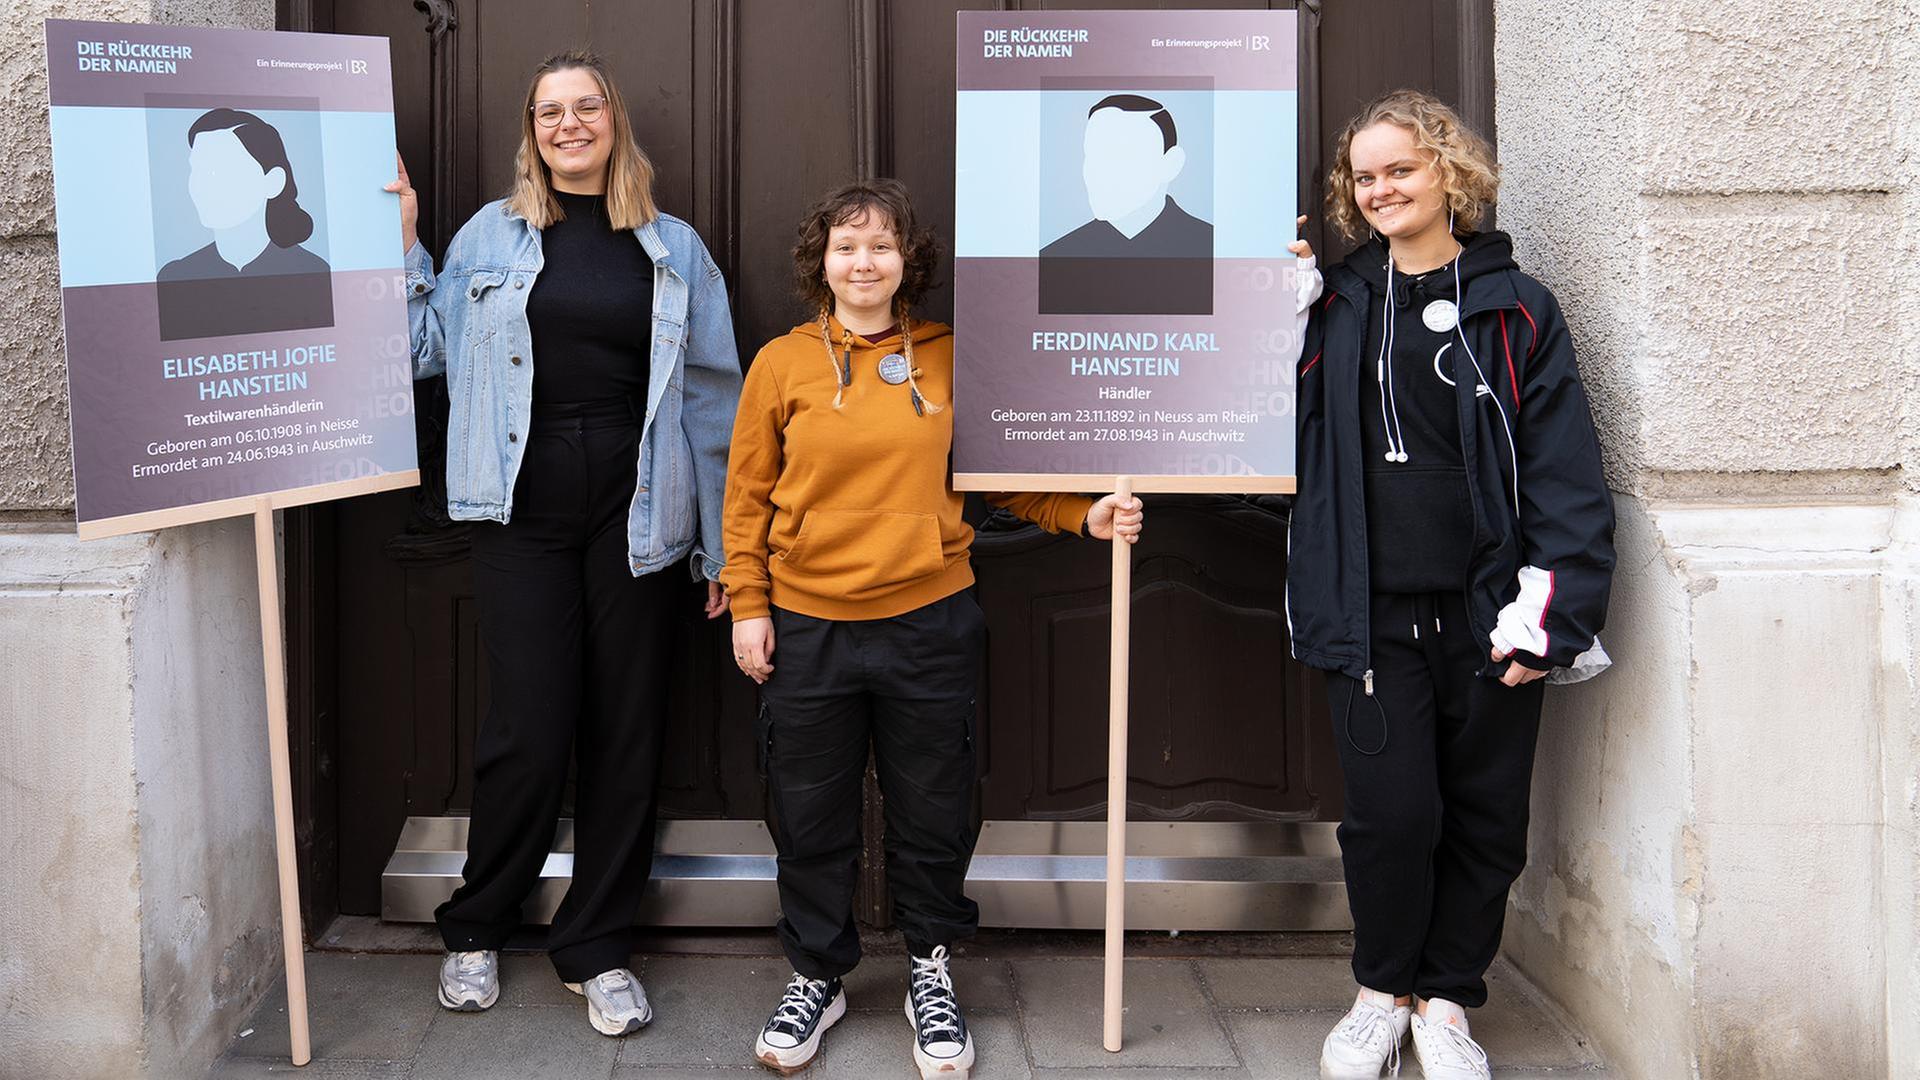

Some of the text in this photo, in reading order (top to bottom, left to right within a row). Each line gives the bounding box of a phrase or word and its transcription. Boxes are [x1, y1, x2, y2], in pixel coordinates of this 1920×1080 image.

[984, 27, 1089, 43] DIE RÜCKKEHR
[1252, 35, 1270, 51] BR
[77, 40, 193, 60] DIE RÜCKKEHR
[984, 44, 1073, 58] DER NAMEN
[1151, 38, 1243, 50] Ein Erinnerungsprojekt
[78, 57, 177, 75] DER NAMEN
[256, 59, 343, 72] Ein Erinnerungsprojekt
[351, 60, 368, 75] BR
[1032, 332, 1220, 352] FERDINAND KARL
[162, 344, 337, 379] ELISABETH JOFIE
[1070, 357, 1181, 376] HANSTEIN
[198, 371, 308, 401] HANSTEIN
[1099, 387, 1153, 400] Händler
[184, 399, 324, 428] Textilwarenhändlerin
[991, 409, 1259, 423] Geboren am 23.11.1892 in Neuss am Rhein
[147, 417, 360, 457] Geboren am 06.10.1908 in Neisse
[1004, 428, 1246, 442] Ermordet am 27.08.1943 in Auschwitz
[132, 433, 374, 479] Ermordet am 24.06.1943 in Auschwitz
